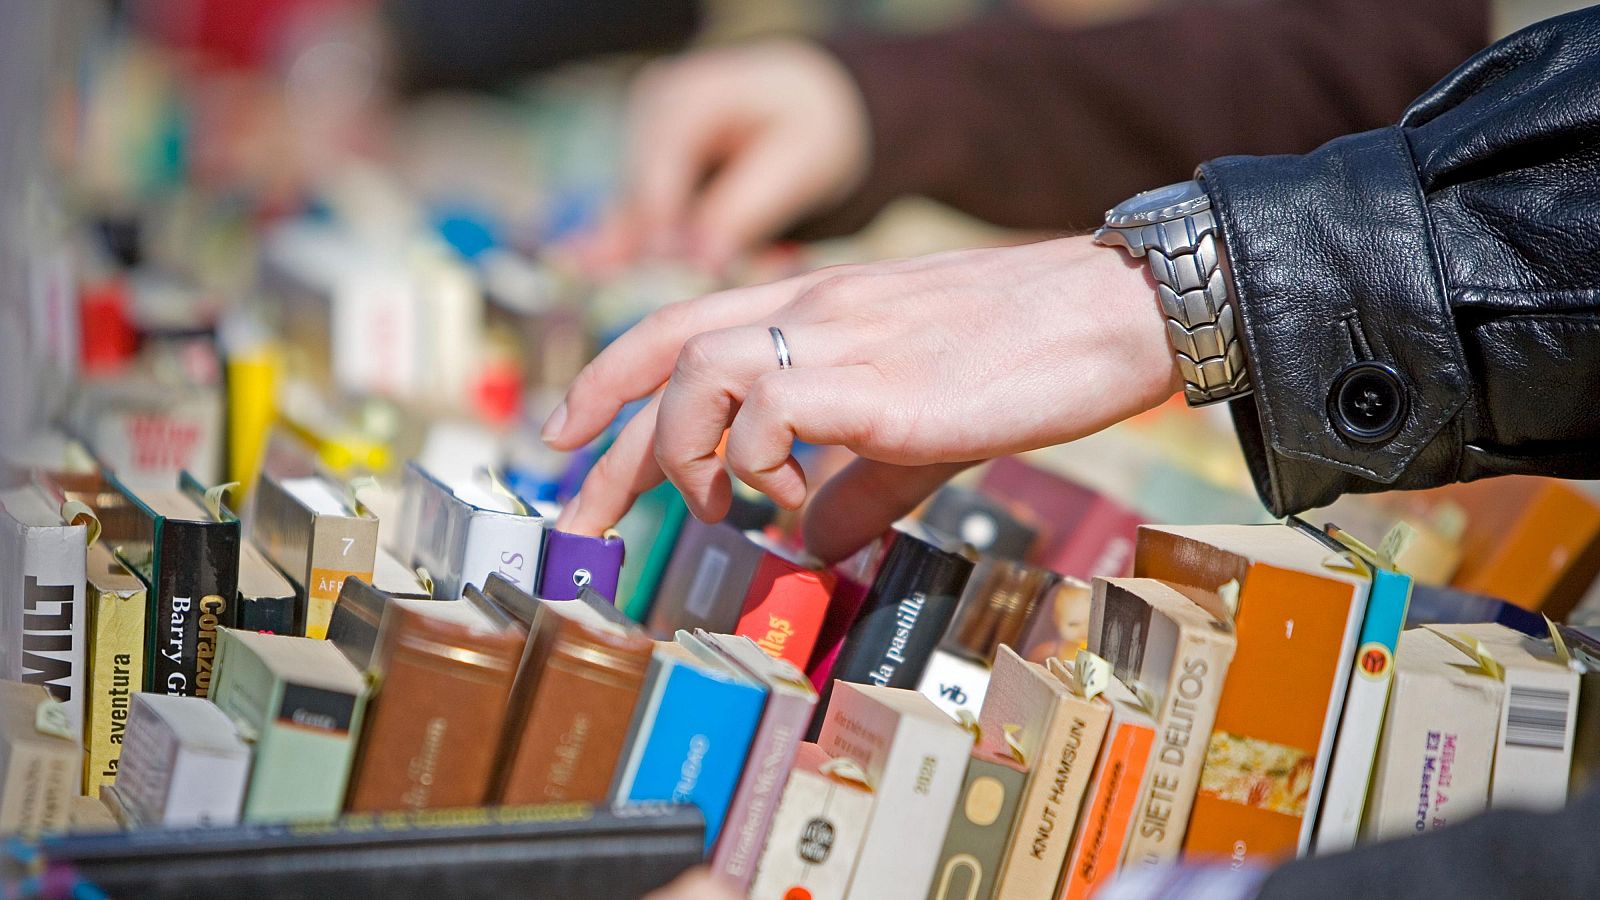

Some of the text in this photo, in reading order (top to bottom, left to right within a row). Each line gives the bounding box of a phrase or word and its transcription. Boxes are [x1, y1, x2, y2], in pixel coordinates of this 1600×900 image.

[161, 596, 191, 665] Barry
[886, 591, 926, 664] pastilla
[108, 653, 131, 745] aventura
[1030, 717, 1087, 861] KNUT HAMSUN
[1140, 773, 1179, 842] SIETE
[1162, 656, 1208, 767] DELITOS
